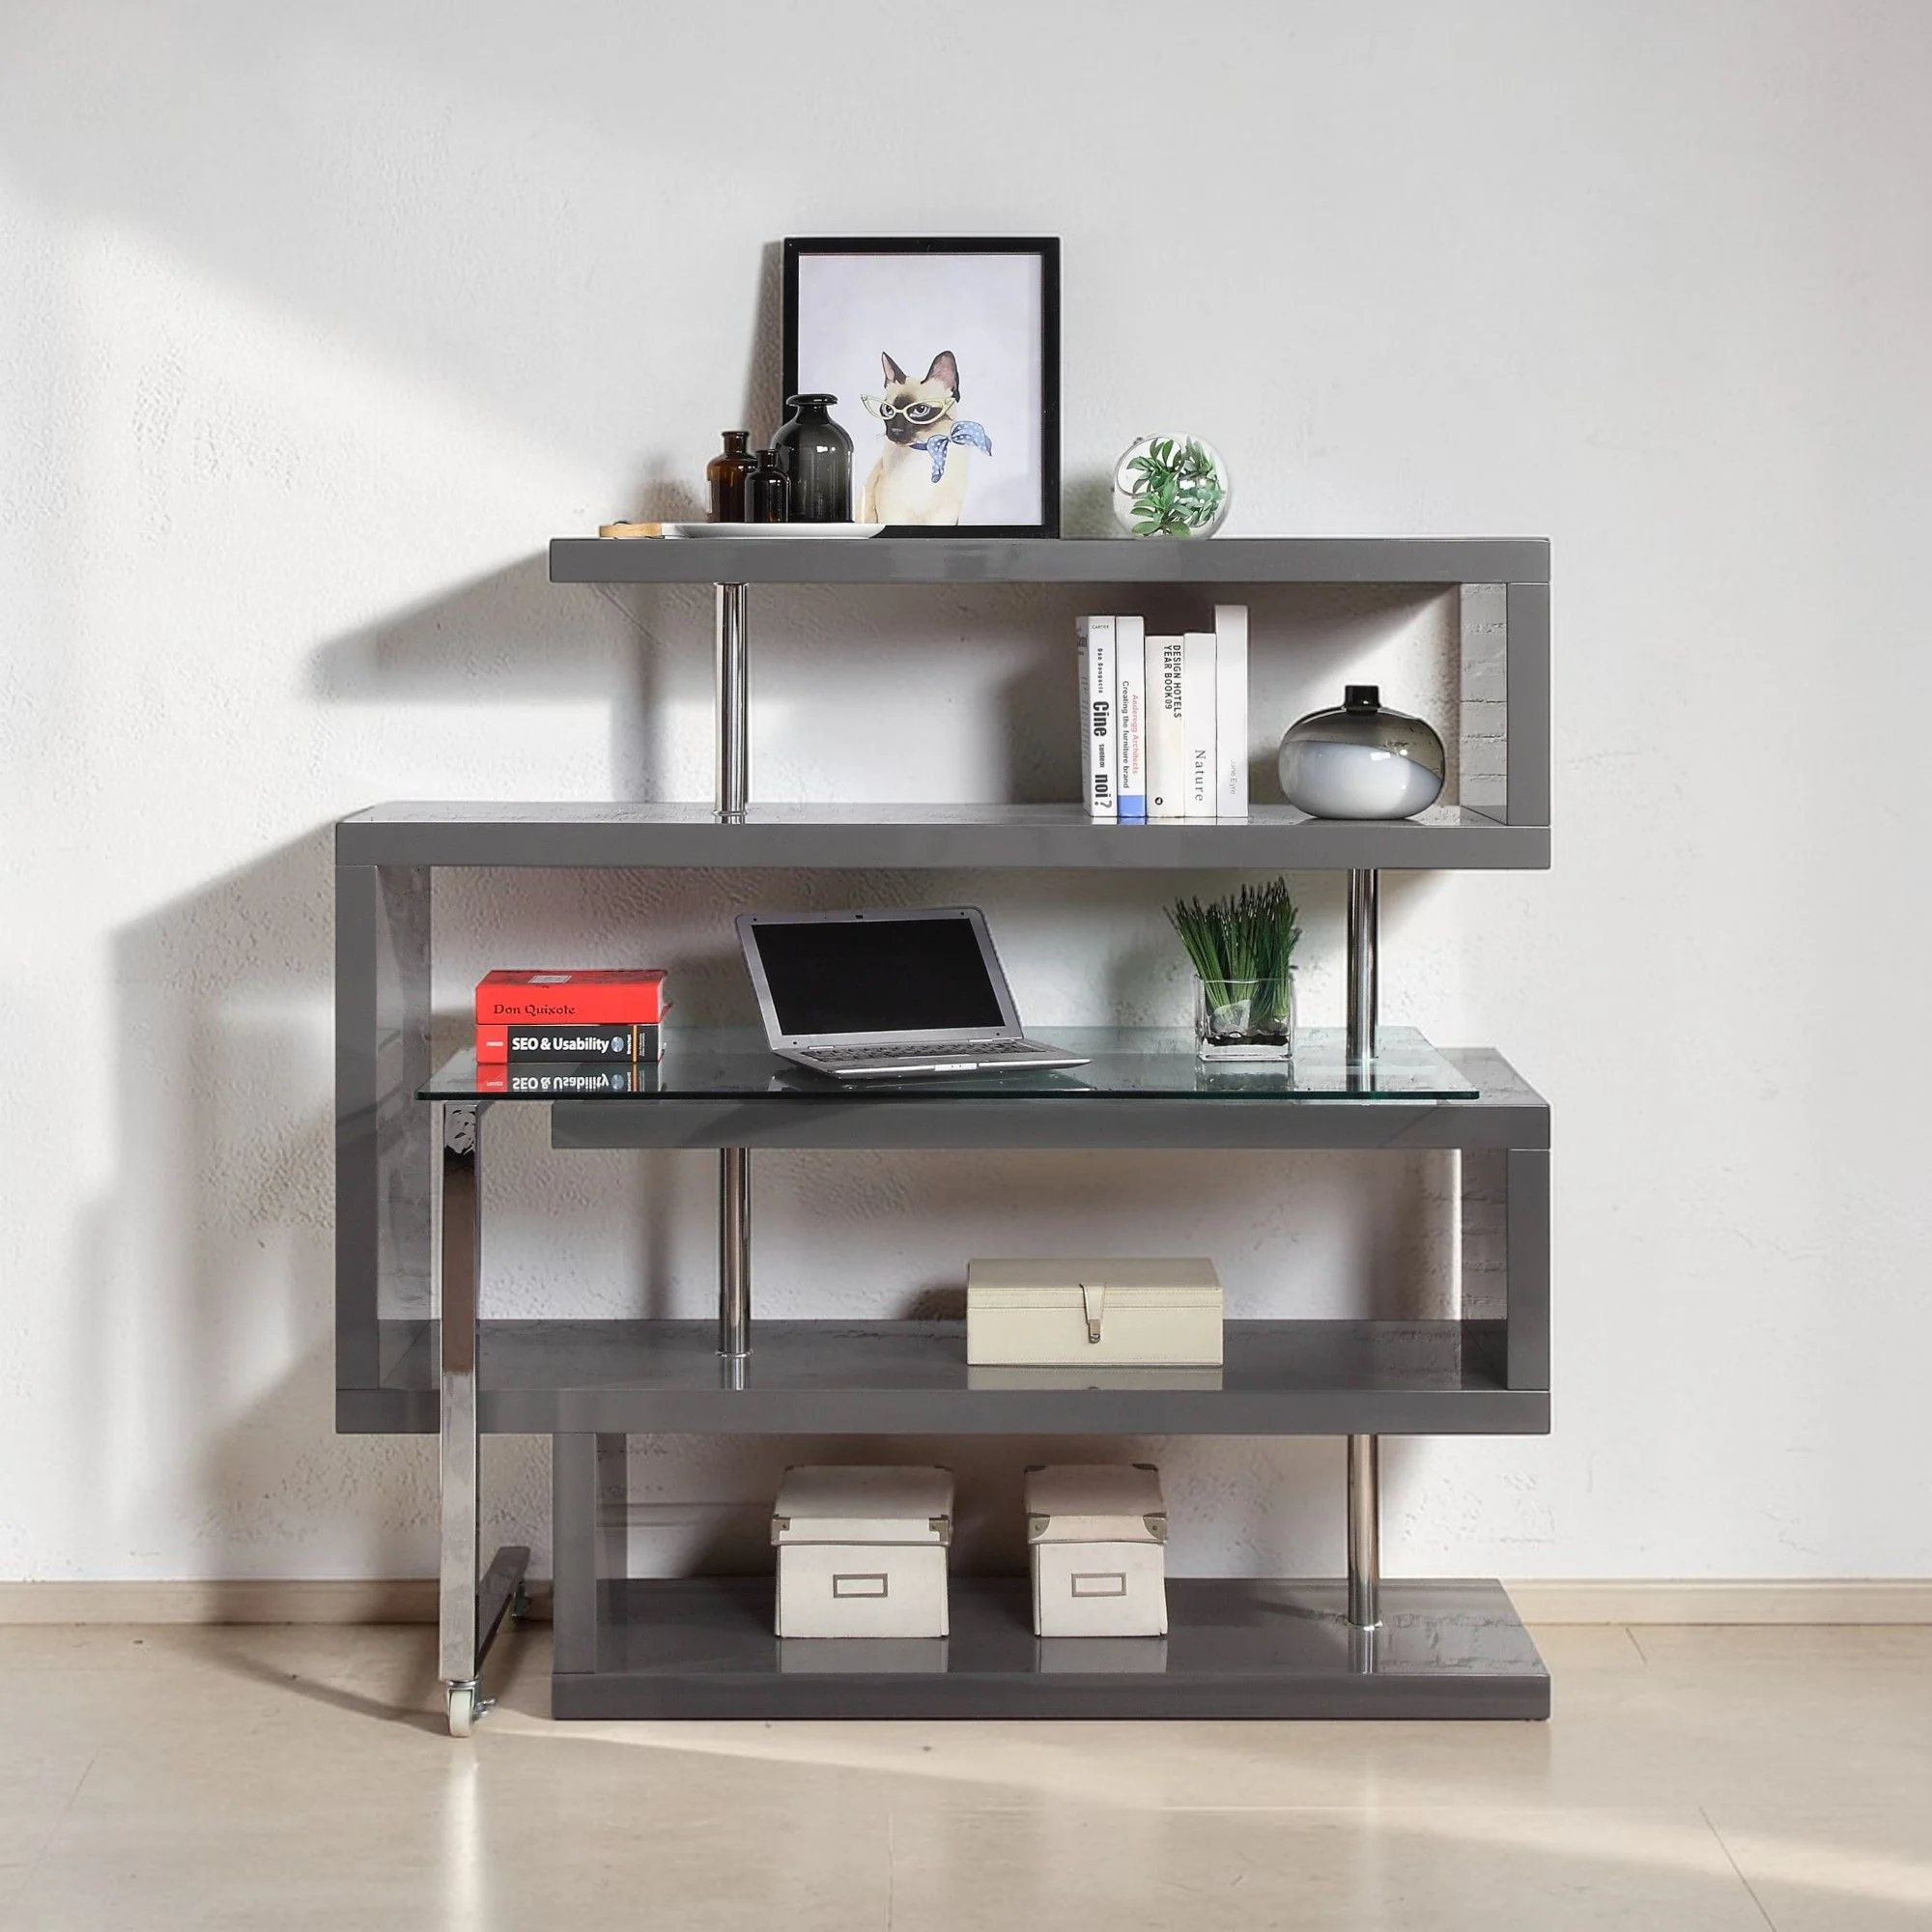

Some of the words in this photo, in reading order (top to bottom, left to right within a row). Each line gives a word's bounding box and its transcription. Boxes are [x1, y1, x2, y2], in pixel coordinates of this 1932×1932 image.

[1164, 644, 1173, 669] YEAR
[1173, 644, 1181, 680] DESIGN
[1122, 680, 1130, 714] Creating
[1130, 695, 1139, 733] Anderegg
[1173, 682, 1182, 719] HOTELS
[1093, 701, 1110, 737] Cine
[1094, 774, 1113, 809] noi?
[1194, 750, 1207, 802] Nature
[1229, 778, 1237, 795] Eyre
[494, 1004, 522, 1014] Don
[525, 1004, 576, 1017] Quixote
[511, 1037, 539, 1051] SEO
[540, 1037, 552, 1051] &
[553, 1036, 610, 1054] Usability
